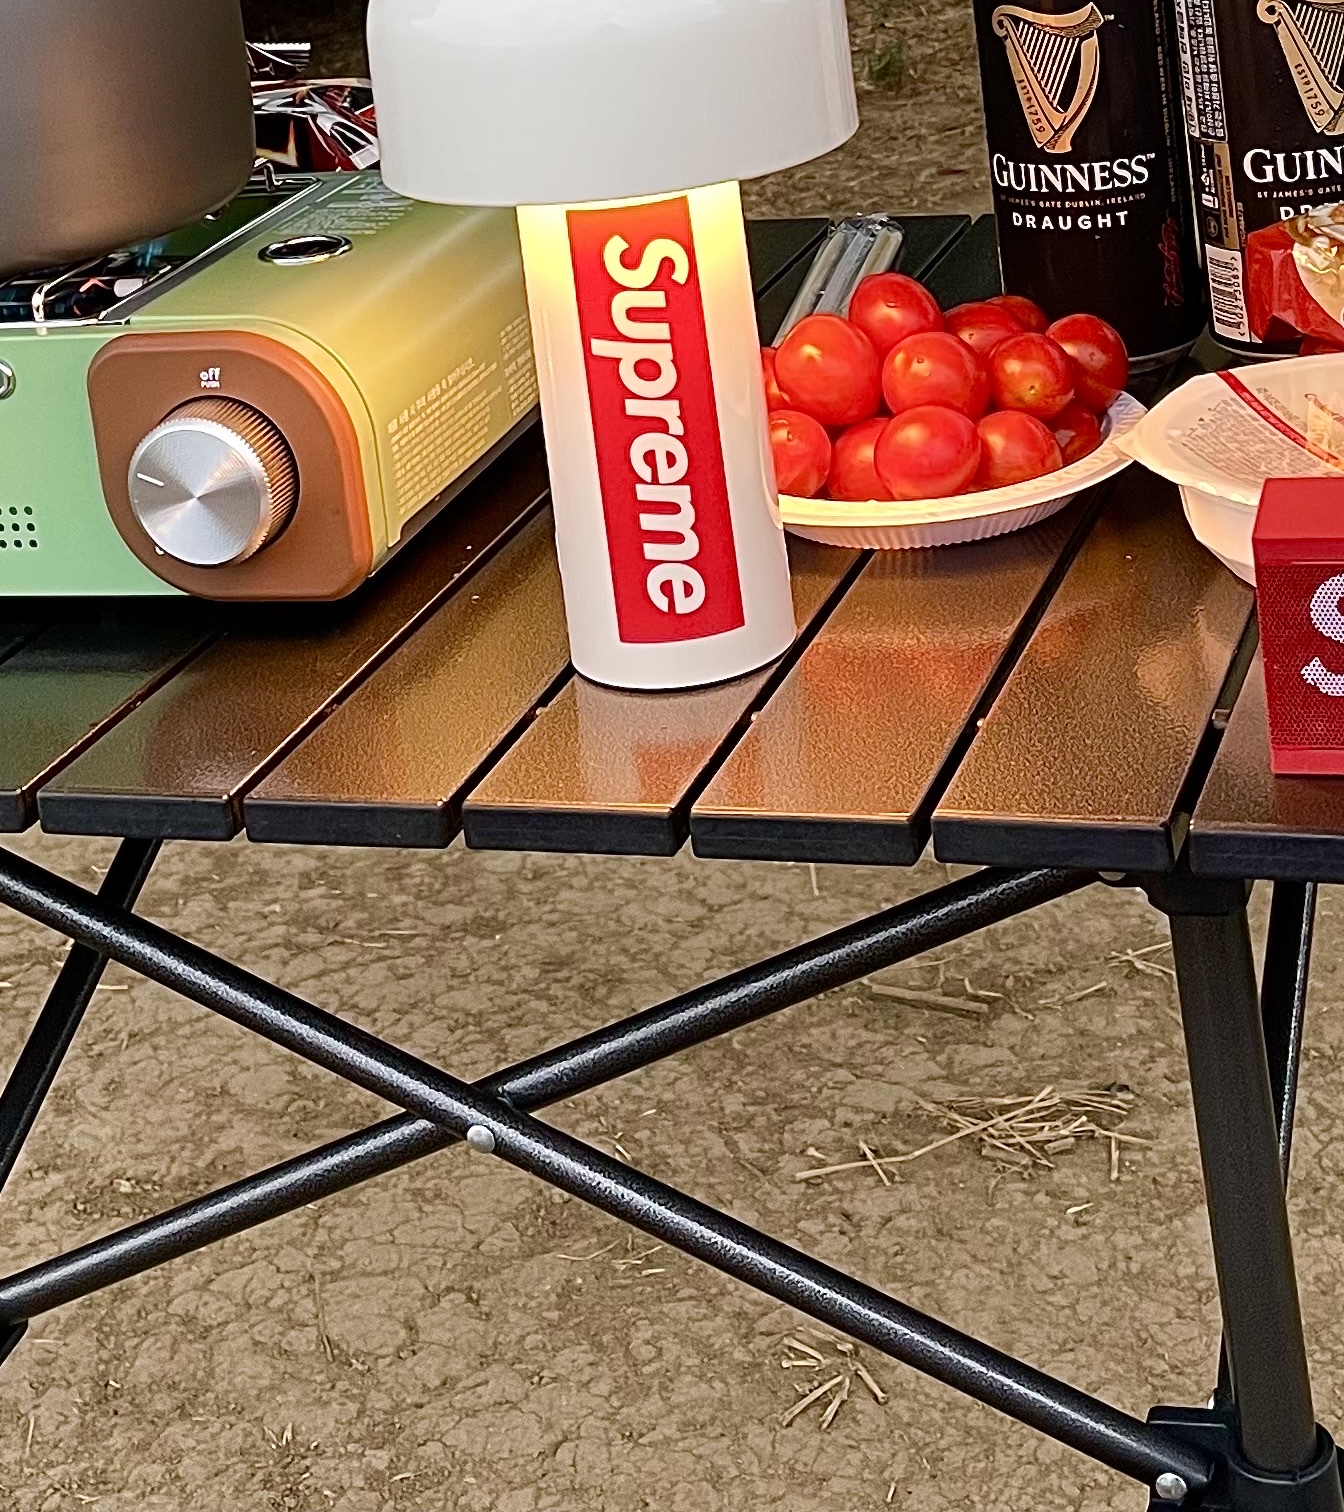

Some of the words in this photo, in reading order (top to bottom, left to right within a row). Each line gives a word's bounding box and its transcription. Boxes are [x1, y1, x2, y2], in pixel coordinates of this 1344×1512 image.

[1303, 88, 1325, 117] 1759
[1026, 104, 1046, 133] 1759
[992, 154, 1149, 193] GUINNESS
[1012, 210, 1129, 231] DRAUGHT
[199, 367, 221, 381] off
[591, 234, 706, 615] Supreme
